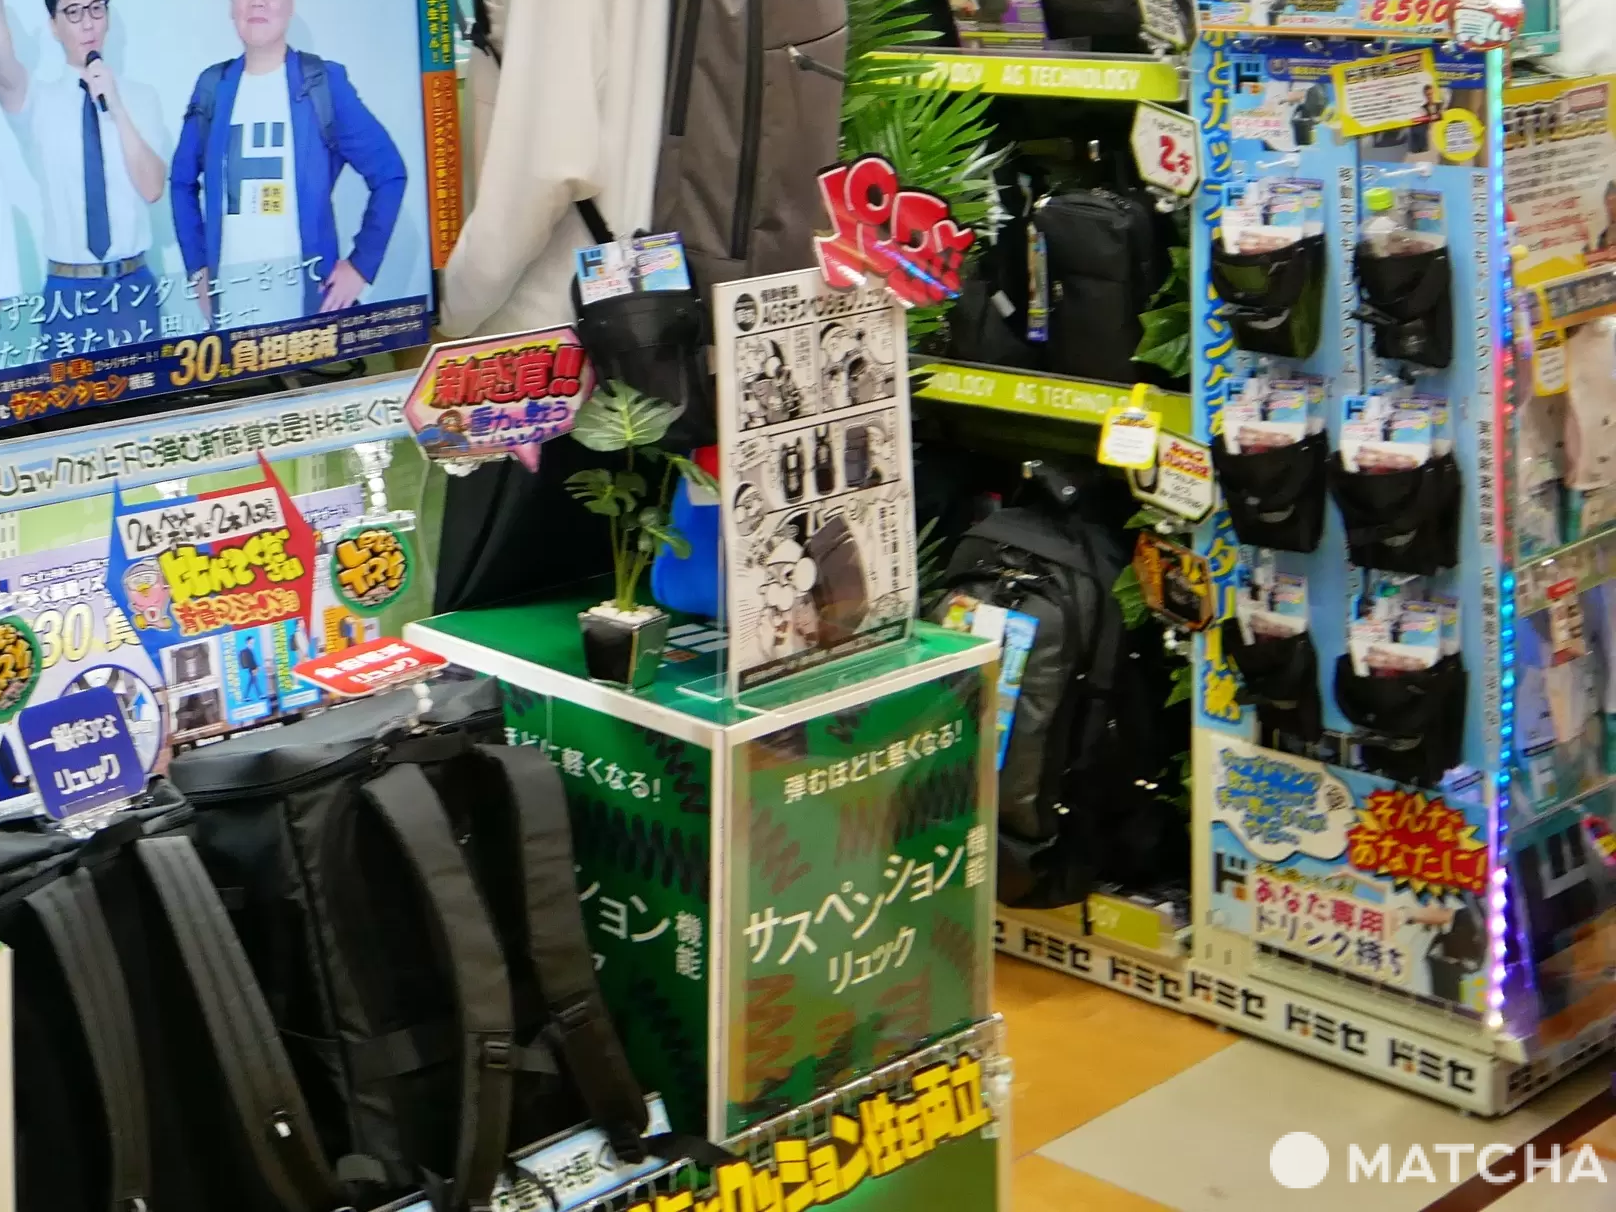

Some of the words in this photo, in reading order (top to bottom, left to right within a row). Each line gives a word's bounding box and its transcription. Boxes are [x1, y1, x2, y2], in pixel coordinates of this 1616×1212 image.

[1031, 64, 1140, 91] TECHNOLOGY
[230, 325, 340, 375] 負担軽減
[10, 375, 128, 419] サスペンション
[53, 754, 121, 795] リュック
[784, 720, 964, 805] 弾むほどに軽くなる!
[1370, 793, 1460, 843] そんな
[743, 843, 966, 966] サスペンション
[1255, 878, 1383, 933] あなた専用
[829, 926, 917, 994] リュック
[1022, 925, 1092, 972] ドミセ
[1108, 955, 1183, 1004] ドミセ
[1188, 968, 1268, 1022] ドミセ
[1286, 1000, 1369, 1057] ドミセ
[1388, 1037, 1476, 1095] ドミセ
